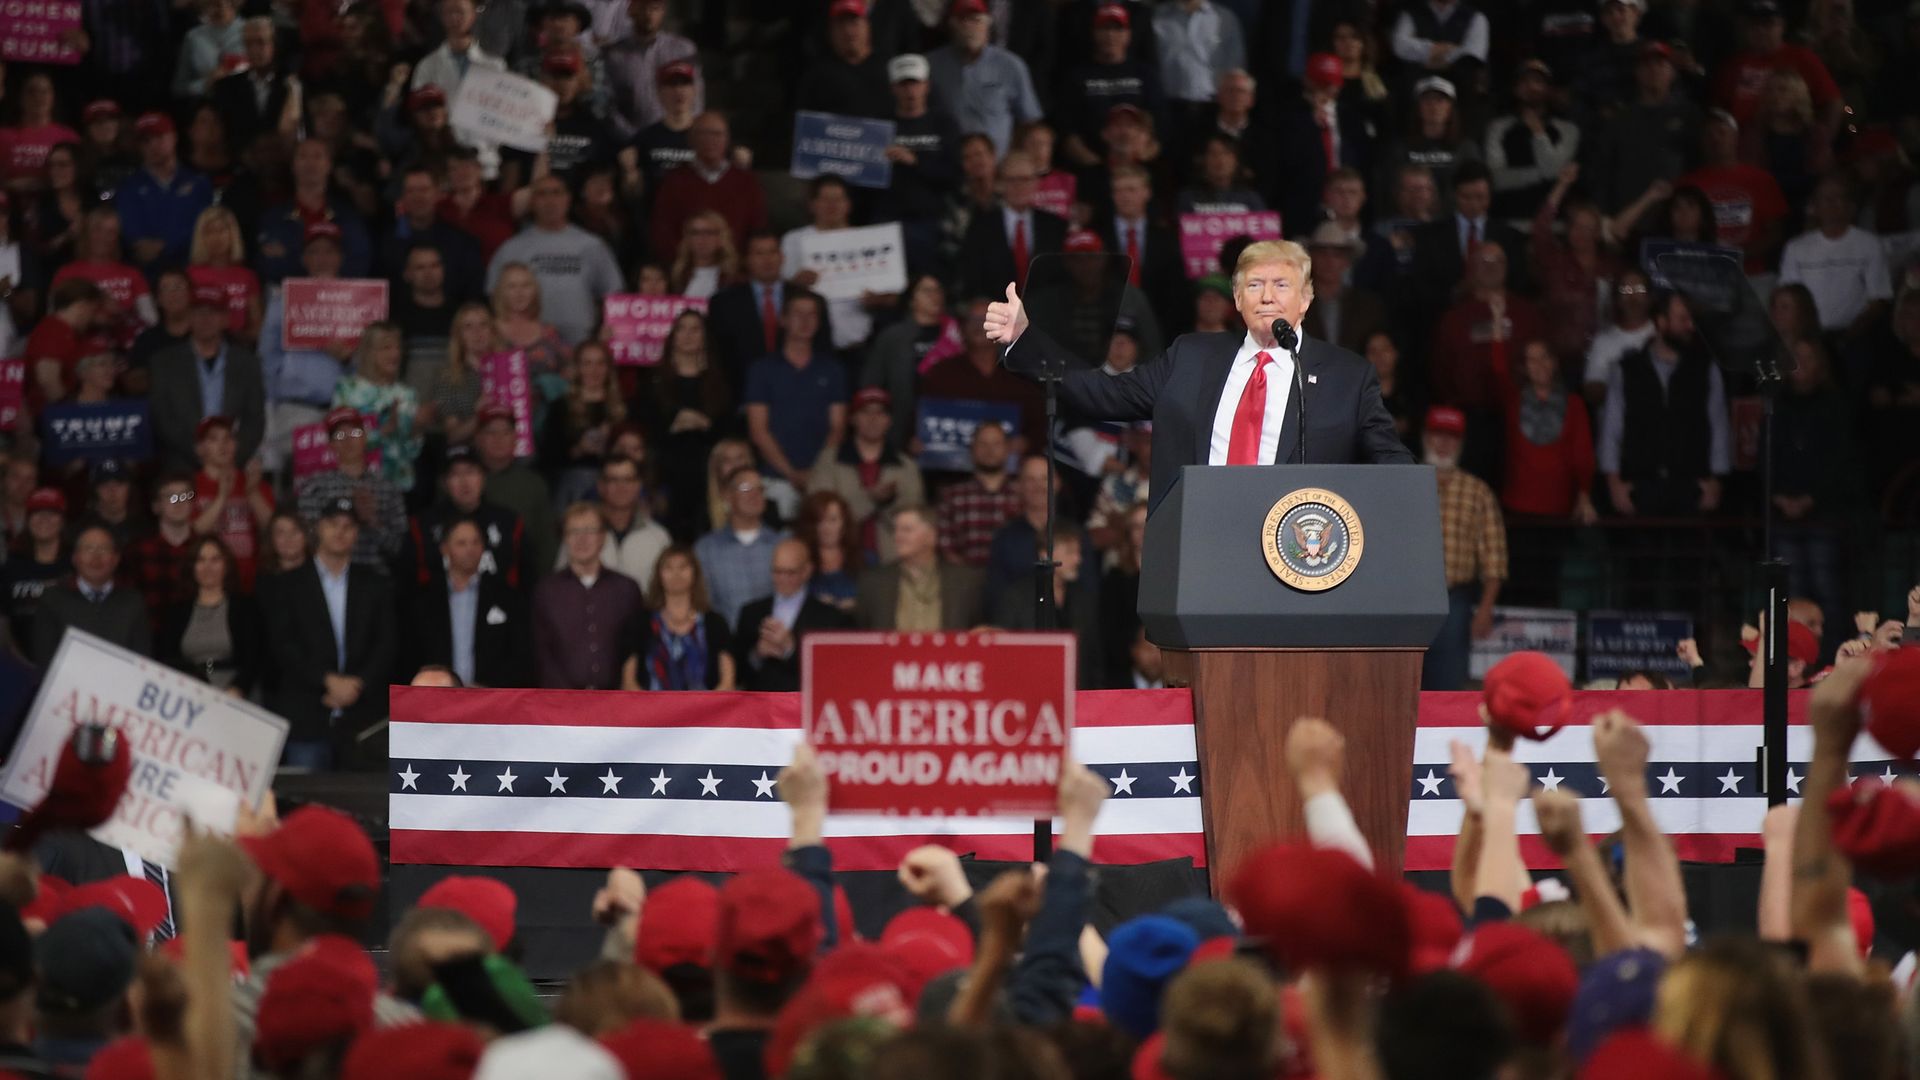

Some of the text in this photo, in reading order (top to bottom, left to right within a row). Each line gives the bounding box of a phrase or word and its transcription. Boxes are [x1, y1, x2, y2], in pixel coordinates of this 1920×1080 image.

[0, 0, 81, 20] OMEN
[1182, 214, 1281, 235] WOMEN
[811, 244, 893, 263] TRUMP
[51, 414, 141, 434] TRUMP
[1265, 492, 1309, 537] PRESIDENT
[1338, 504, 1360, 546] UNITED
[1280, 567, 1304, 585] SEAL
[1321, 555, 1356, 586] STATES
[893, 660, 984, 692] MAKE
[137, 682, 204, 729] BUY
[813, 700, 1065, 747] AMERICA
[817, 751, 1060, 786] PROUD AGAIN
